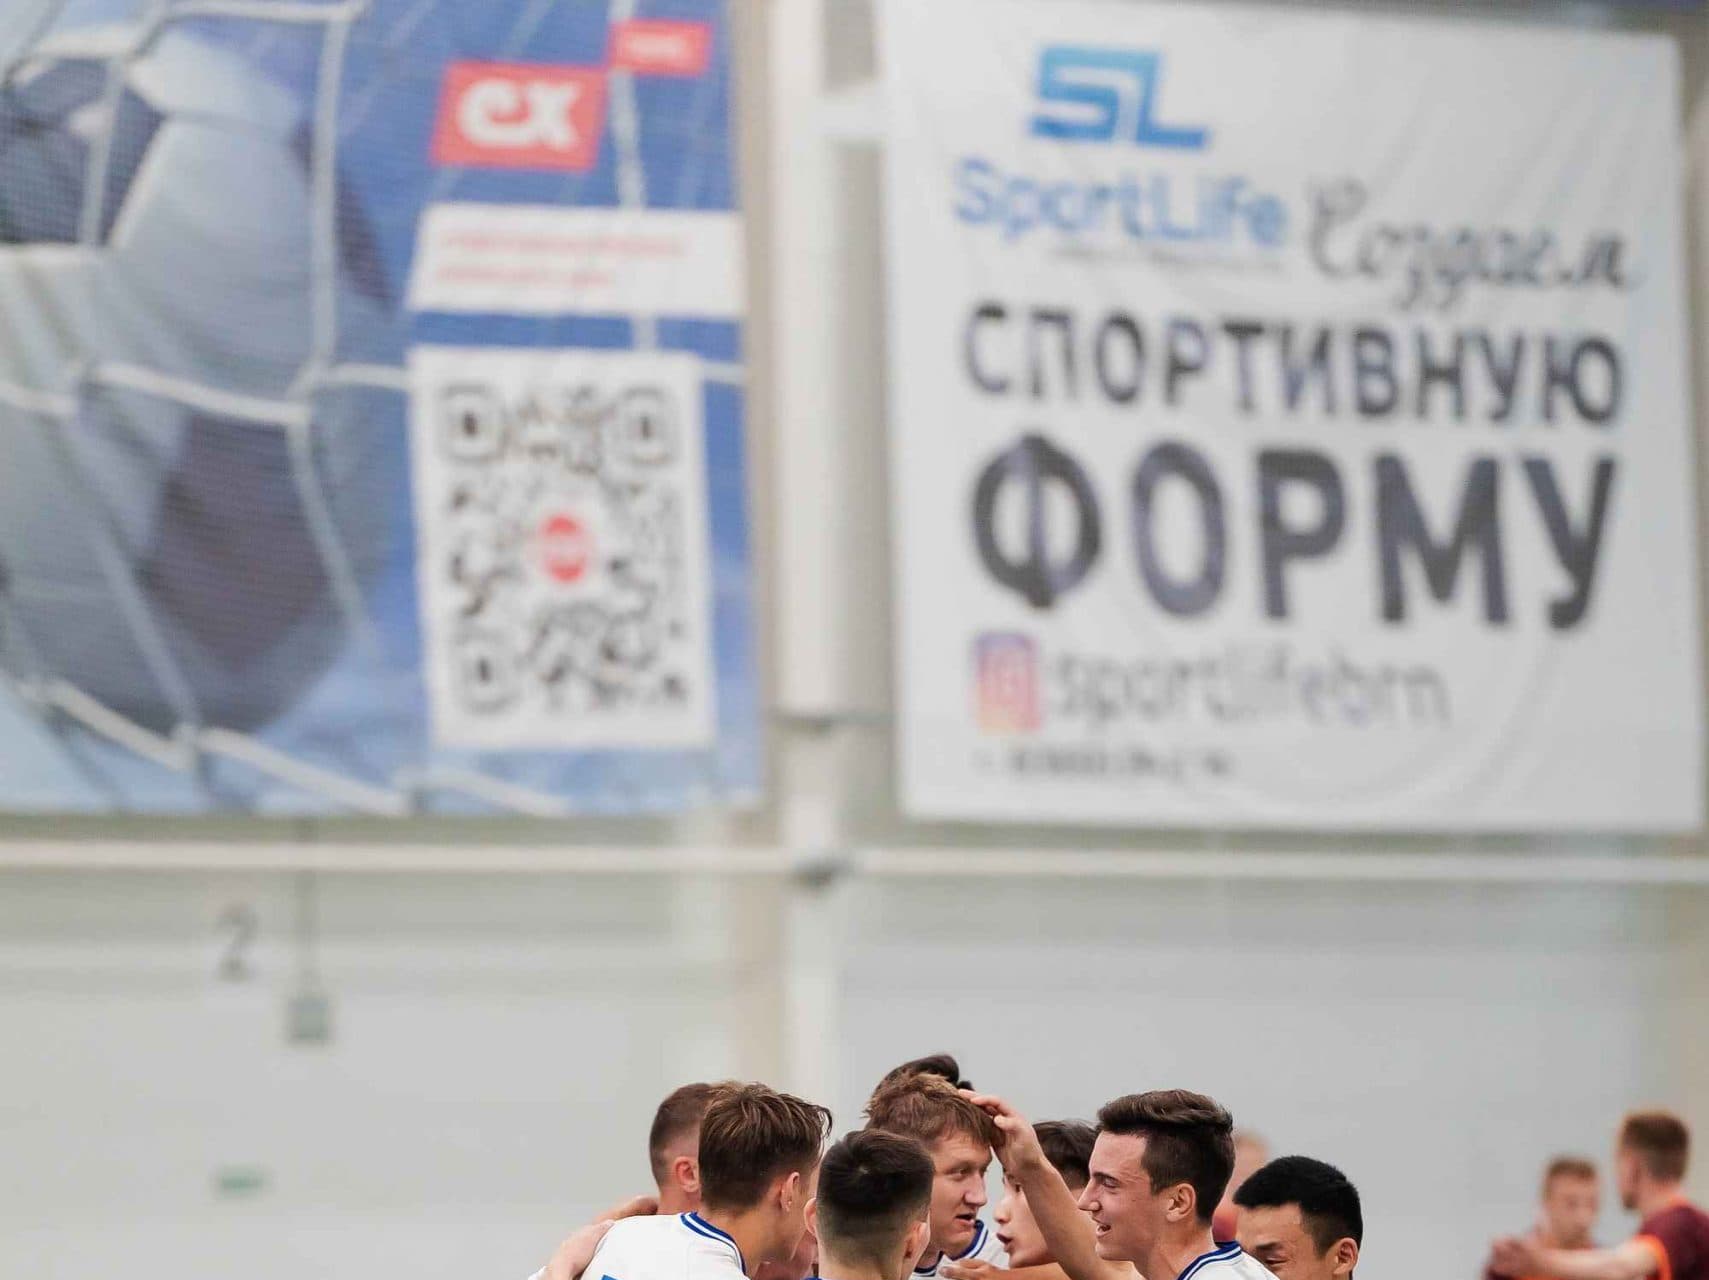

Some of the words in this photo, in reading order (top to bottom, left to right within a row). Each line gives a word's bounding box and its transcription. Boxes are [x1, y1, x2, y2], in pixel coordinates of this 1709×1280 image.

[1029, 46, 1212, 151] SL
[967, 303, 1623, 424] СПОРТИВНУЮ
[972, 432, 1616, 629] ФОРМУ
